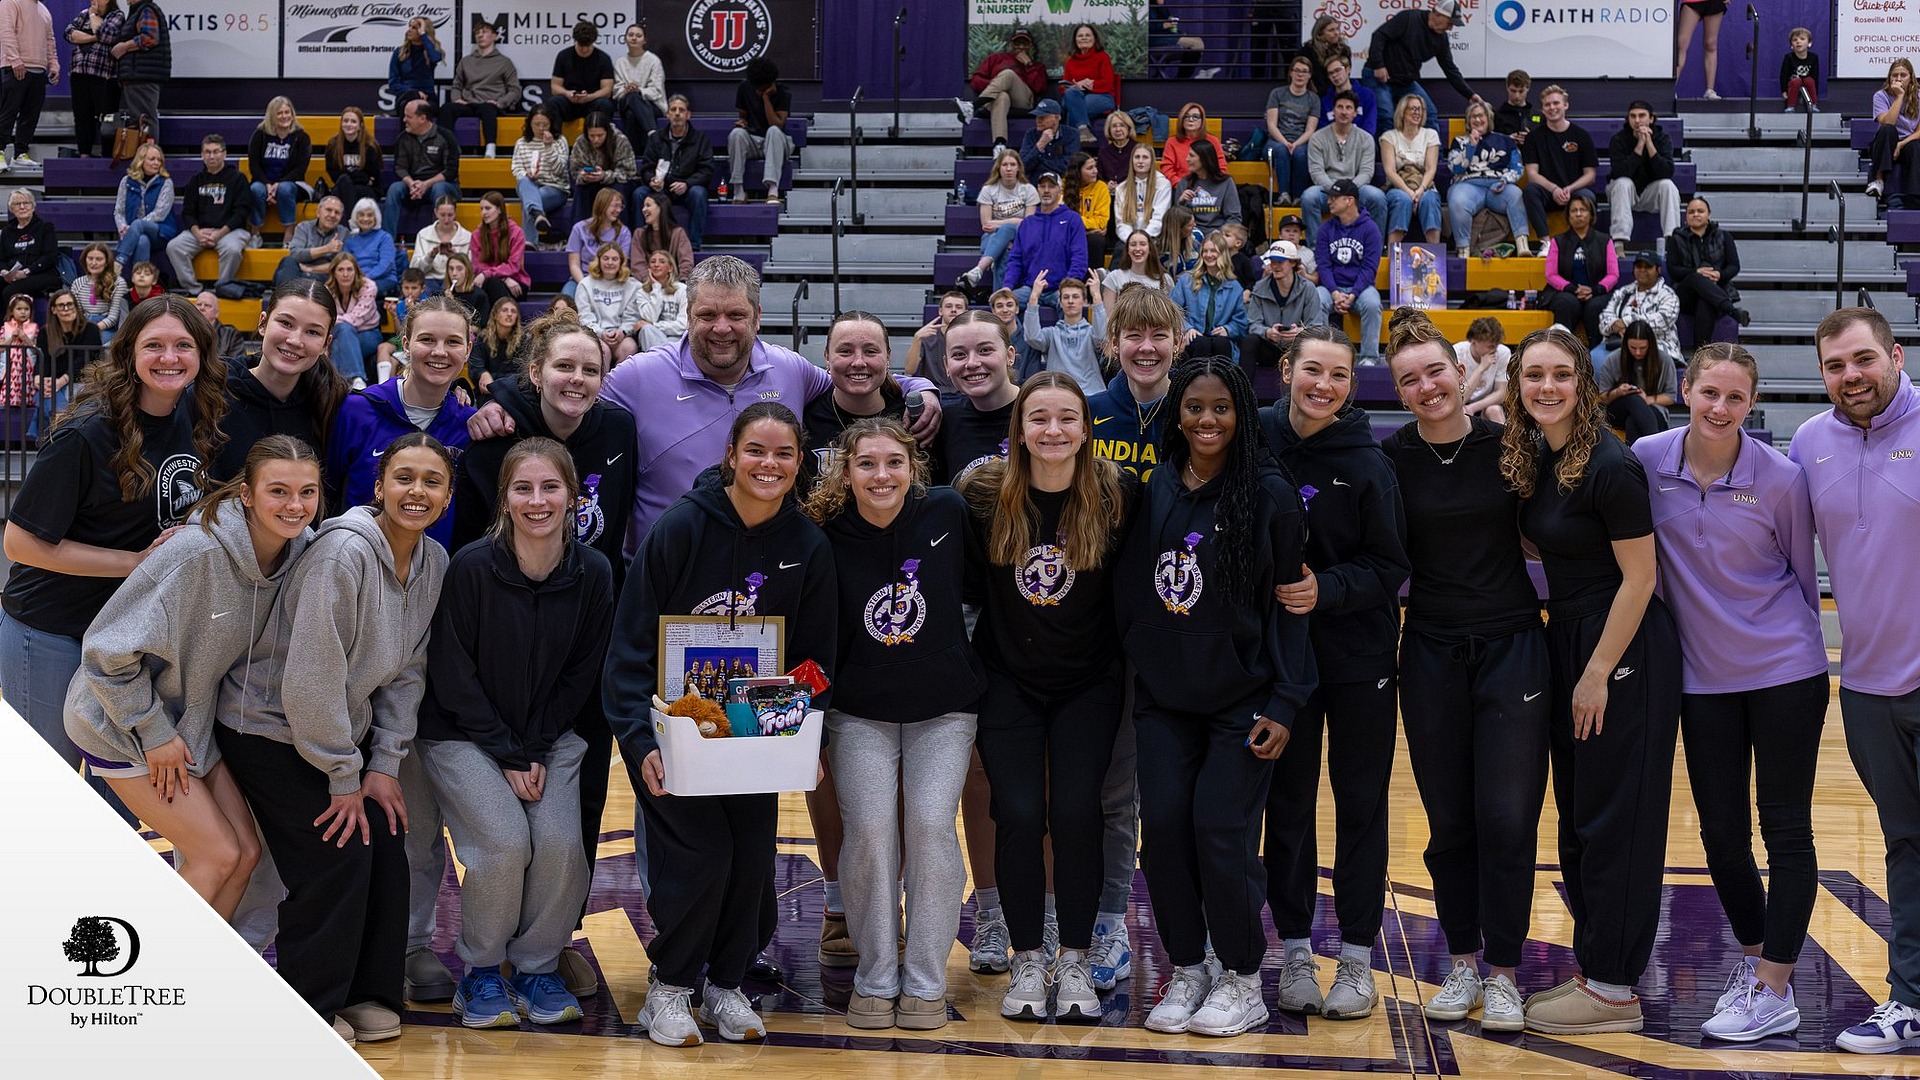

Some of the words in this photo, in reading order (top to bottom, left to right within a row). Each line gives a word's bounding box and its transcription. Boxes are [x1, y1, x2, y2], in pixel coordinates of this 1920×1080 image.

[288, 4, 358, 19] Minnesota
[976, 5, 985, 14] &
[987, 4, 1031, 14] NURSERY
[1379, 0, 1422, 9] COLD
[1427, 0, 1479, 9] SNE
[168, 14, 218, 31] KTIS
[224, 13, 269, 32] 98.5
[514, 12, 626, 29] MILLSOP
[1532, 9, 1594, 23] FAITH
[1600, 8, 1668, 23] RADIO
[710, 10, 749, 50] JJ
[298, 45, 321, 53] Official
[322, 45, 370, 54] Transportation
[696, 42, 761, 67] SANDWICHES
[760, 391, 780, 400] UNW
[1892, 450, 1914, 460] UNW
[1733, 493, 1760, 505] UNW
[758, 699, 805, 736] Trolli
